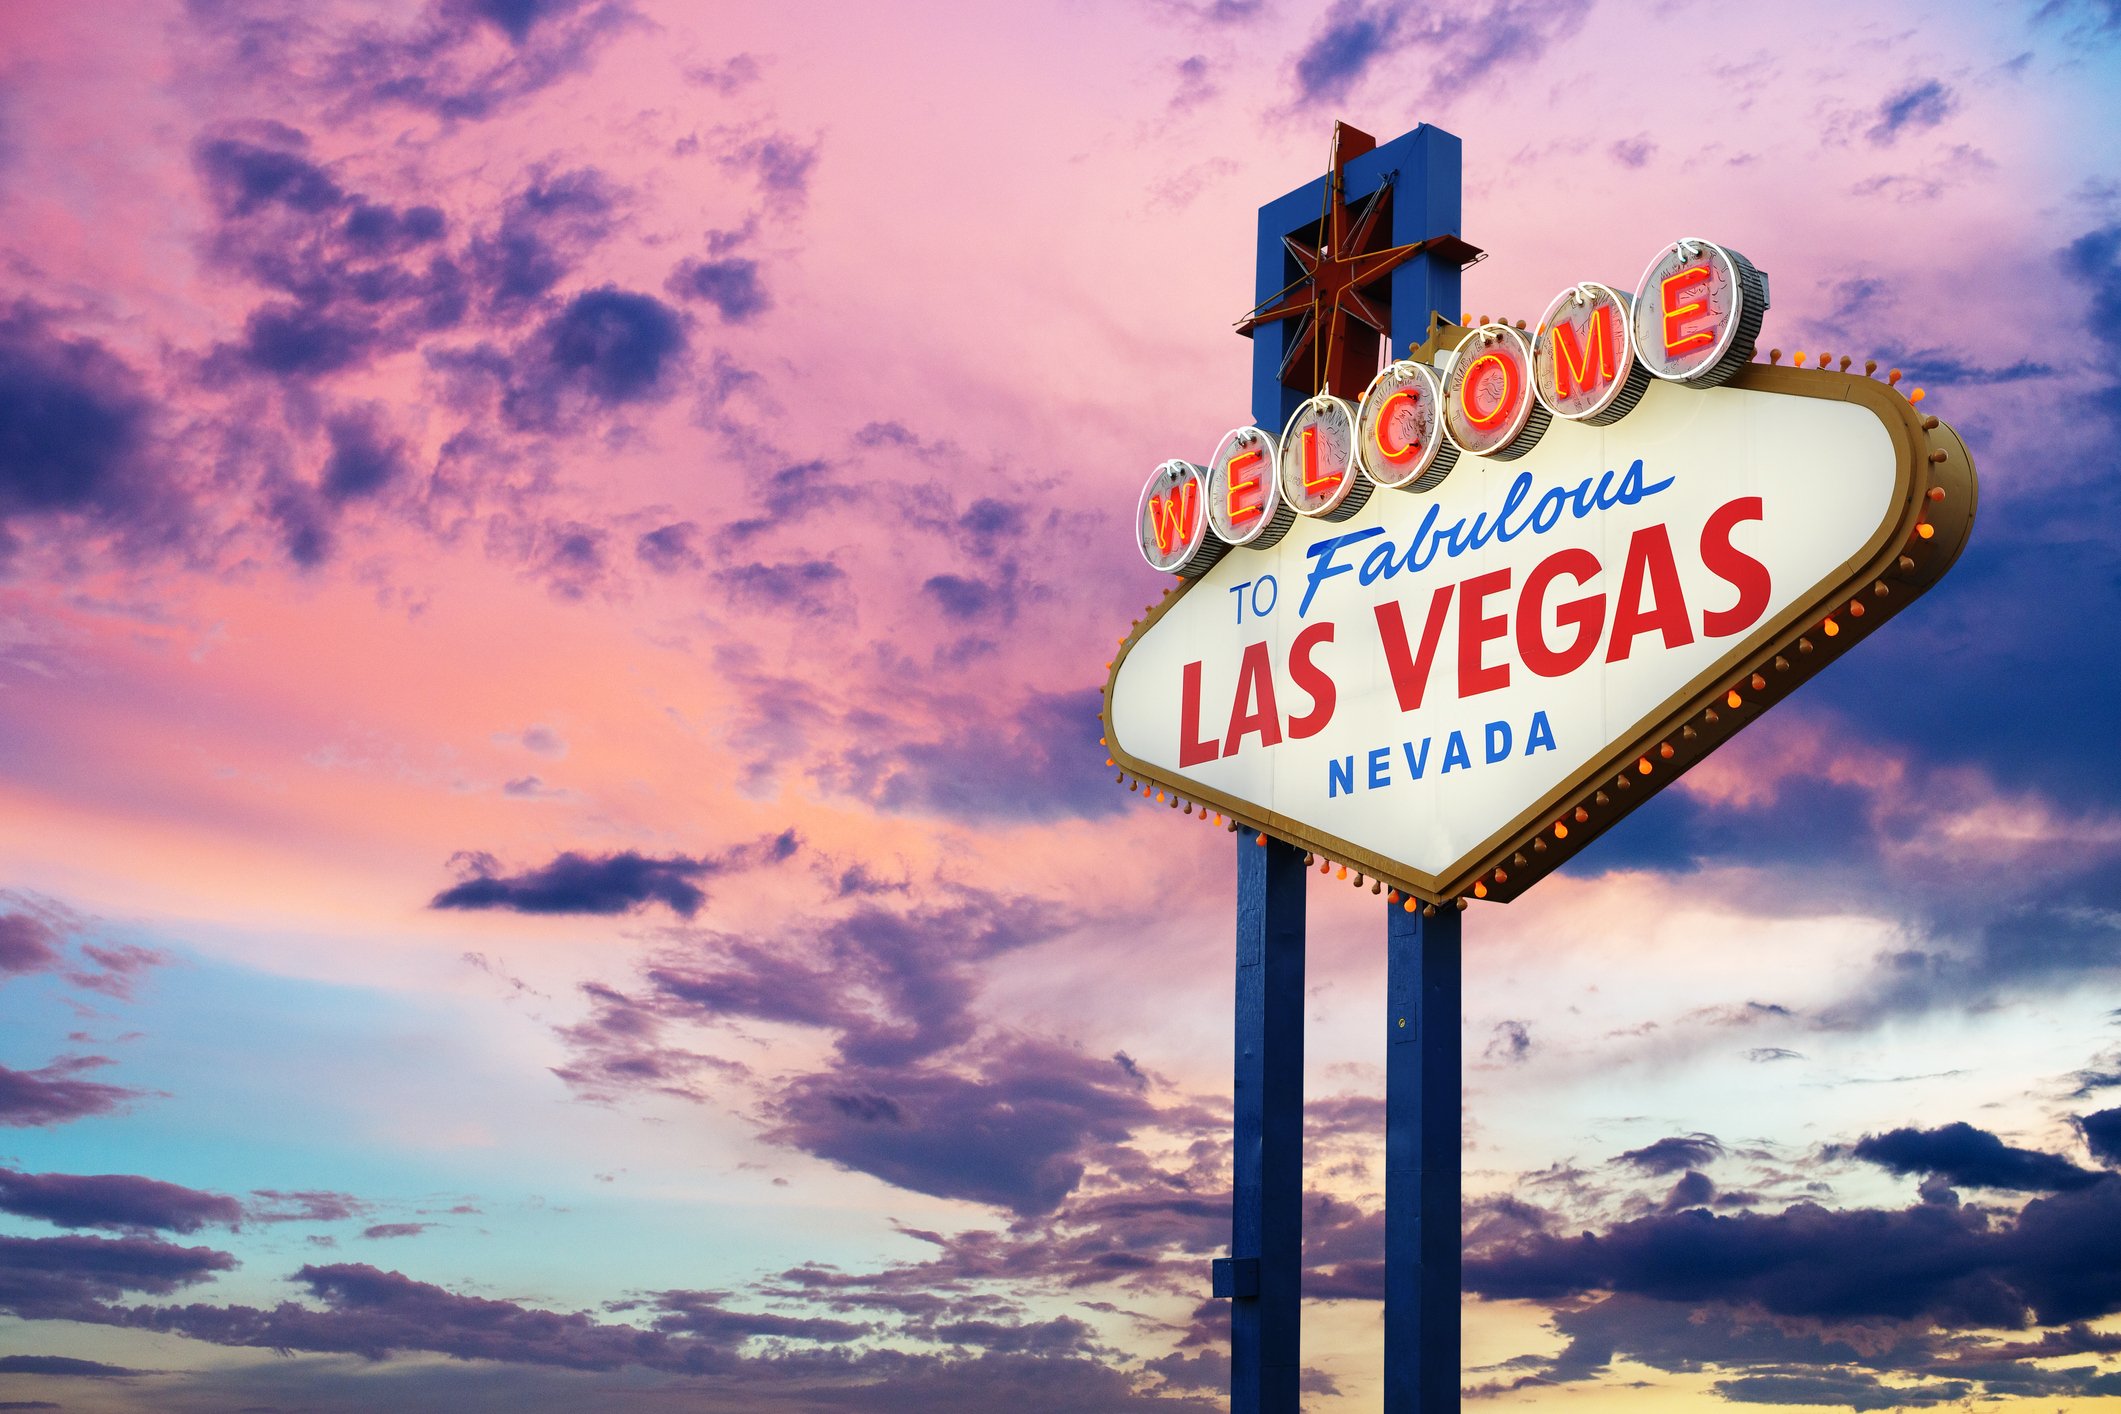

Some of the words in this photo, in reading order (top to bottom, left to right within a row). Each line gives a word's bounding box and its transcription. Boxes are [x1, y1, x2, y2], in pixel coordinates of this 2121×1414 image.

[1149, 264, 1716, 557] WELCOME
[1179, 621, 1337, 768] LAS
[1373, 496, 1772, 713] VEGAS
[1229, 575, 1278, 625] TO
[1298, 458, 1676, 618] Fabulous
[1328, 710, 1557, 799] NEVADA
